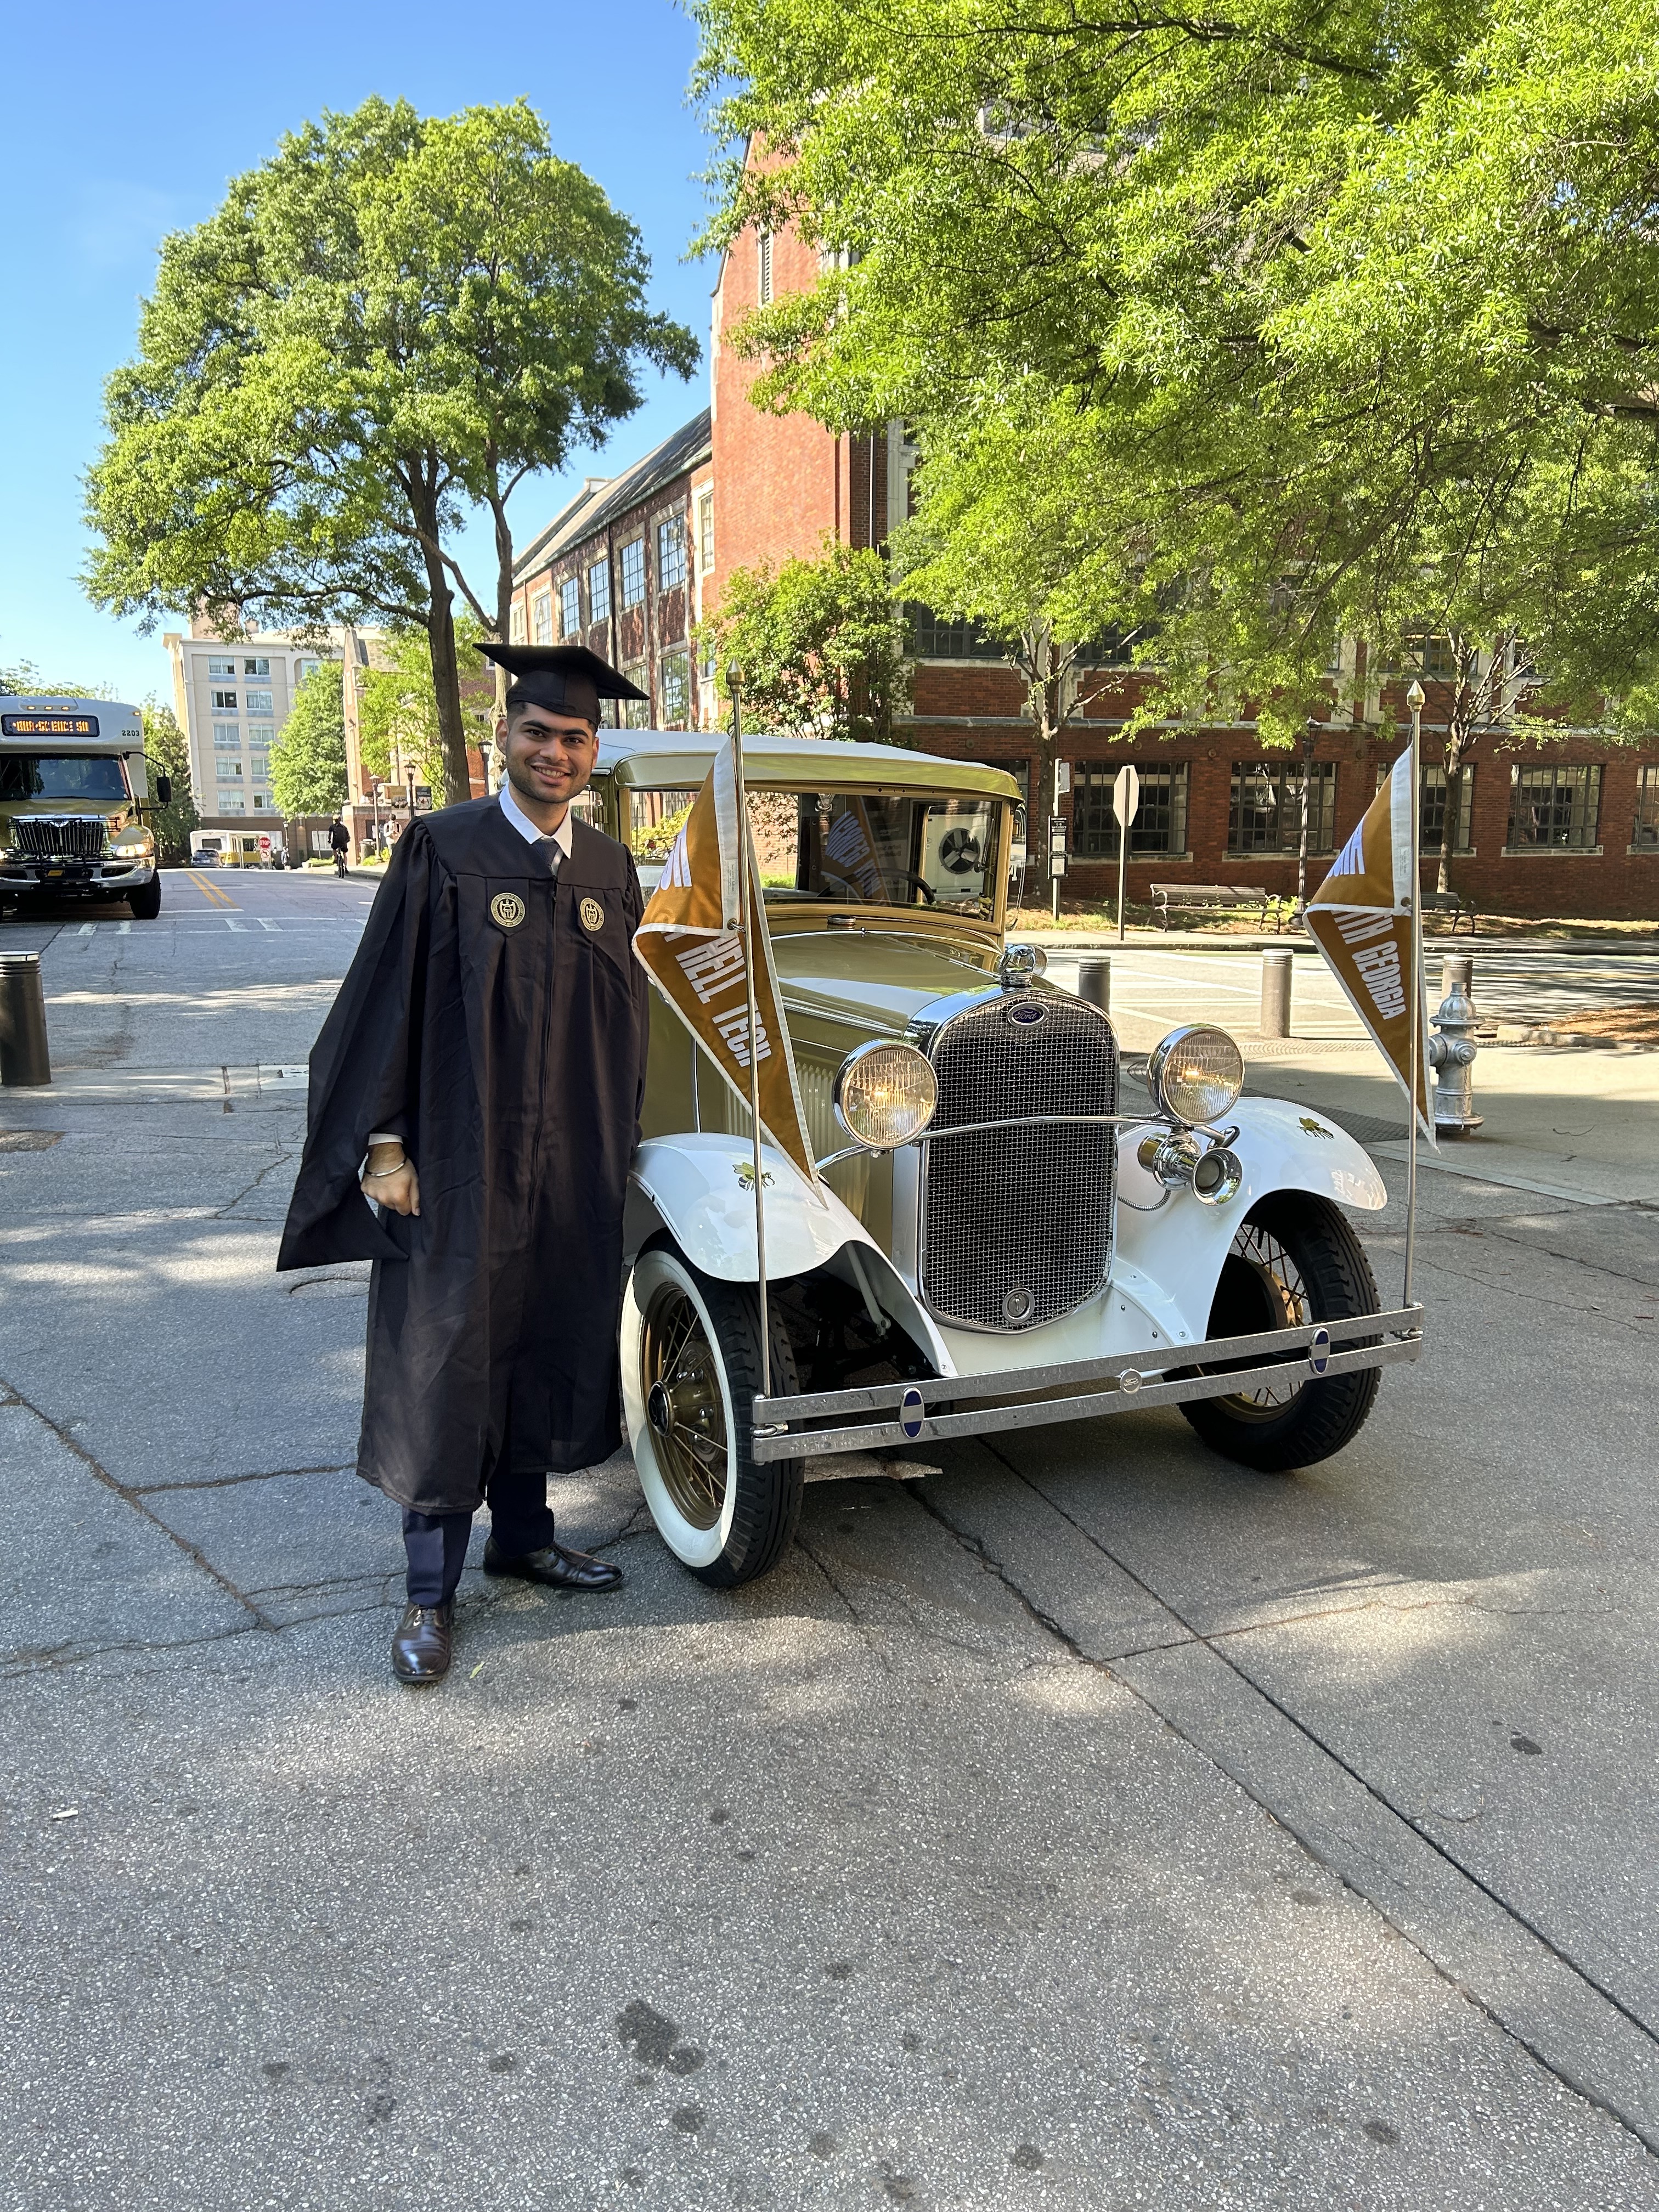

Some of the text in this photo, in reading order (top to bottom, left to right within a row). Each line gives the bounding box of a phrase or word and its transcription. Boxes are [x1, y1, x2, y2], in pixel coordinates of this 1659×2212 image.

[675, 936, 747, 1005] HELL
[712, 998, 772, 1068] TECH
[1014, 1010, 1037, 1020] Ford
[1351, 940, 1407, 1021] GEORGIA
